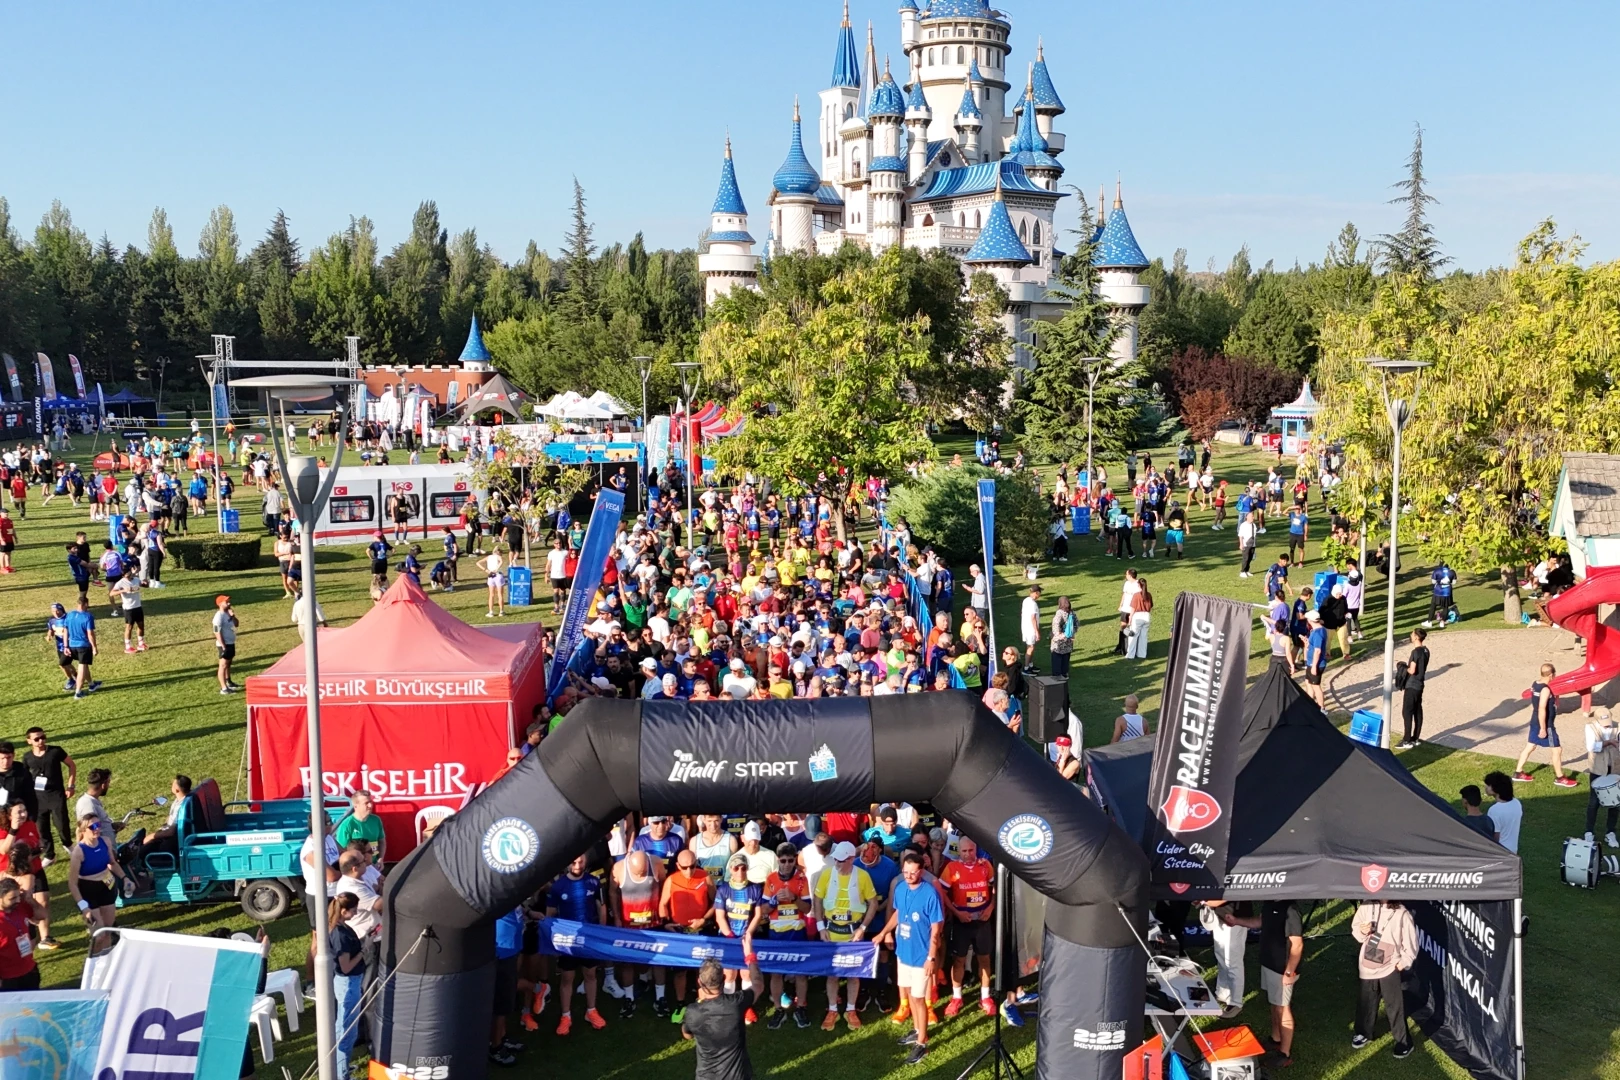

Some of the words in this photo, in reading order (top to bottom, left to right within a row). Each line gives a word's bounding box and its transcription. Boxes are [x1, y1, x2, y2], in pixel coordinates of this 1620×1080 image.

[34, 396, 42, 434] SALOMON
[605, 501, 620, 512] VEGA
[277, 679, 369, 699] ESKŞEHİR
[376, 678, 488, 698] BÜYÜKŞEHİR
[1177, 617, 1215, 788] RACETIMING
[1202, 631, 1225, 785] www.racetiming.com.tr
[667, 759, 729, 783] Lifalif
[734, 760, 799, 777] START
[1156, 840, 1186, 854] Lider
[1188, 842, 1215, 858] Chip
[1163, 856, 1207, 869] Sistemi
[1387, 871, 1484, 885] RACETIMING
[612, 939, 669, 953] START
[756, 951, 811, 962] START
[1447, 952, 1499, 1023] YAKALA
[1096, 1020, 1128, 1032] EVENT
[1073, 1028, 1126, 1045] 2:23
[415, 1055, 452, 1067] EVENT
